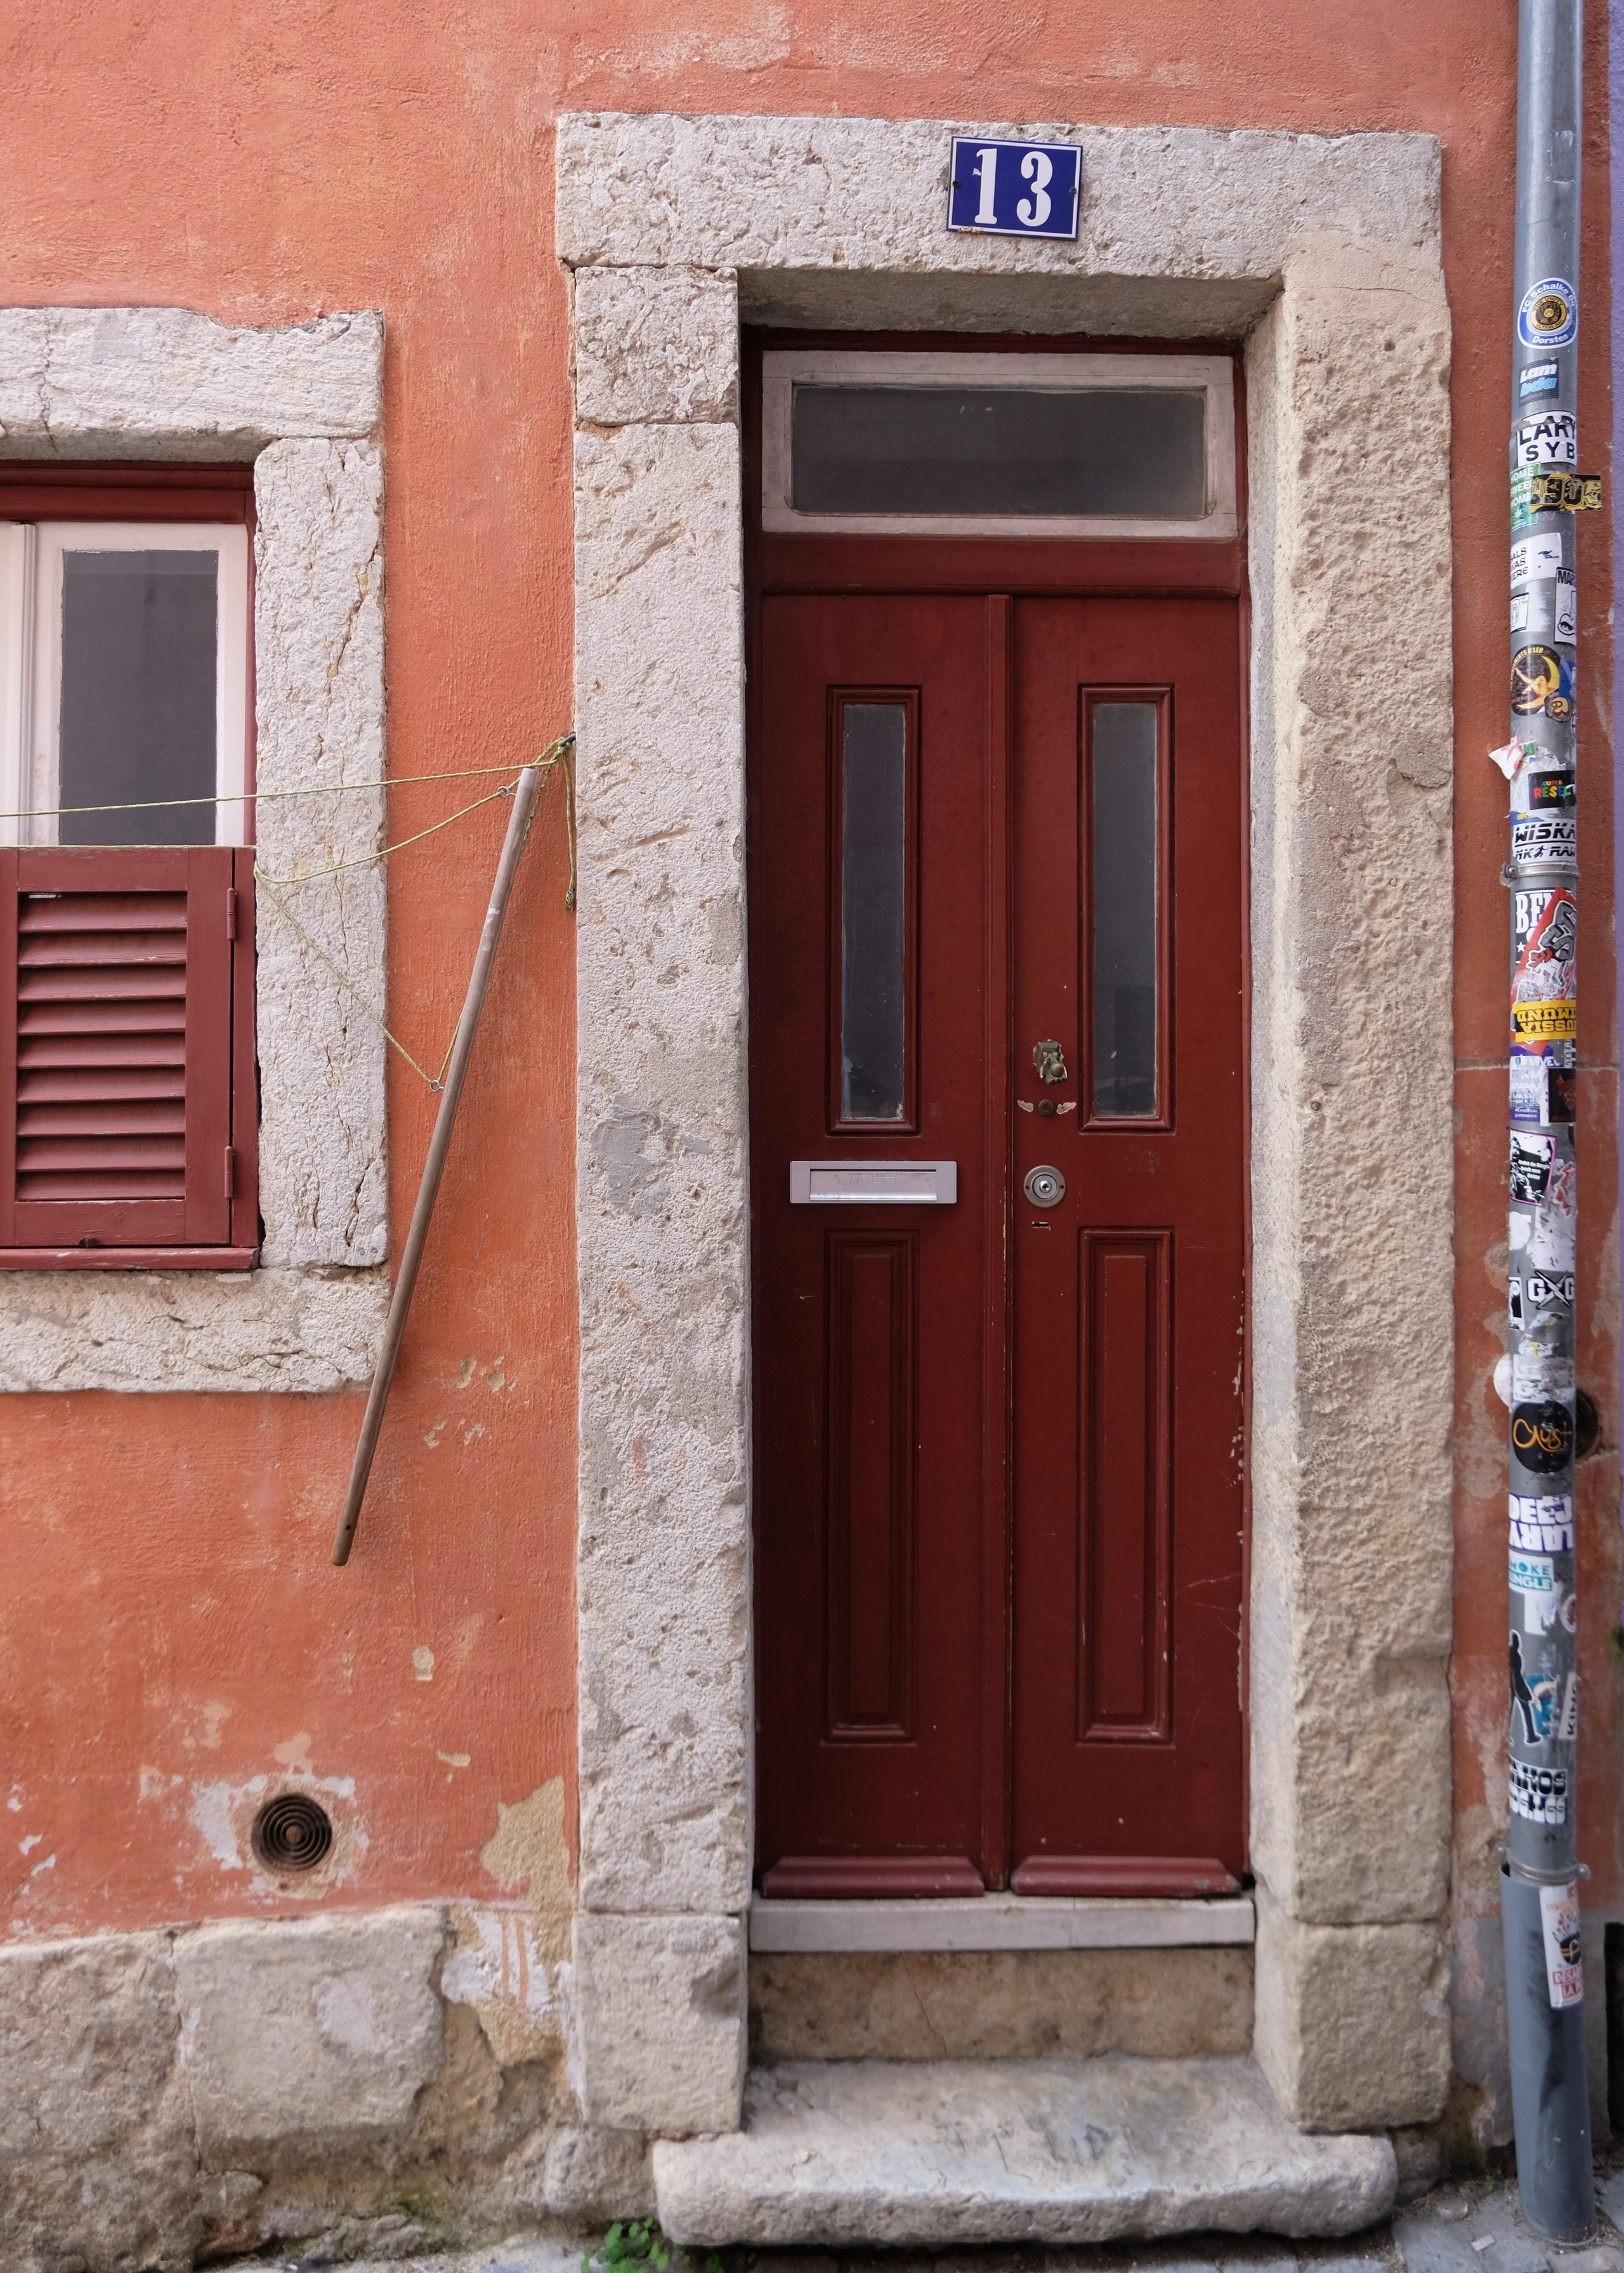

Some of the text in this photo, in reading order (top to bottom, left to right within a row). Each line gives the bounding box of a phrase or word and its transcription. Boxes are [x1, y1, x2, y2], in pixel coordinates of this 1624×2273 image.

[974, 148, 1052, 226] 13
[1522, 299, 1531, 313] FC
[1531, 282, 1569, 299] Schalke
[1532, 334, 1568, 344] Dorsten
[838, 1176, 908, 1188] CORREIO
